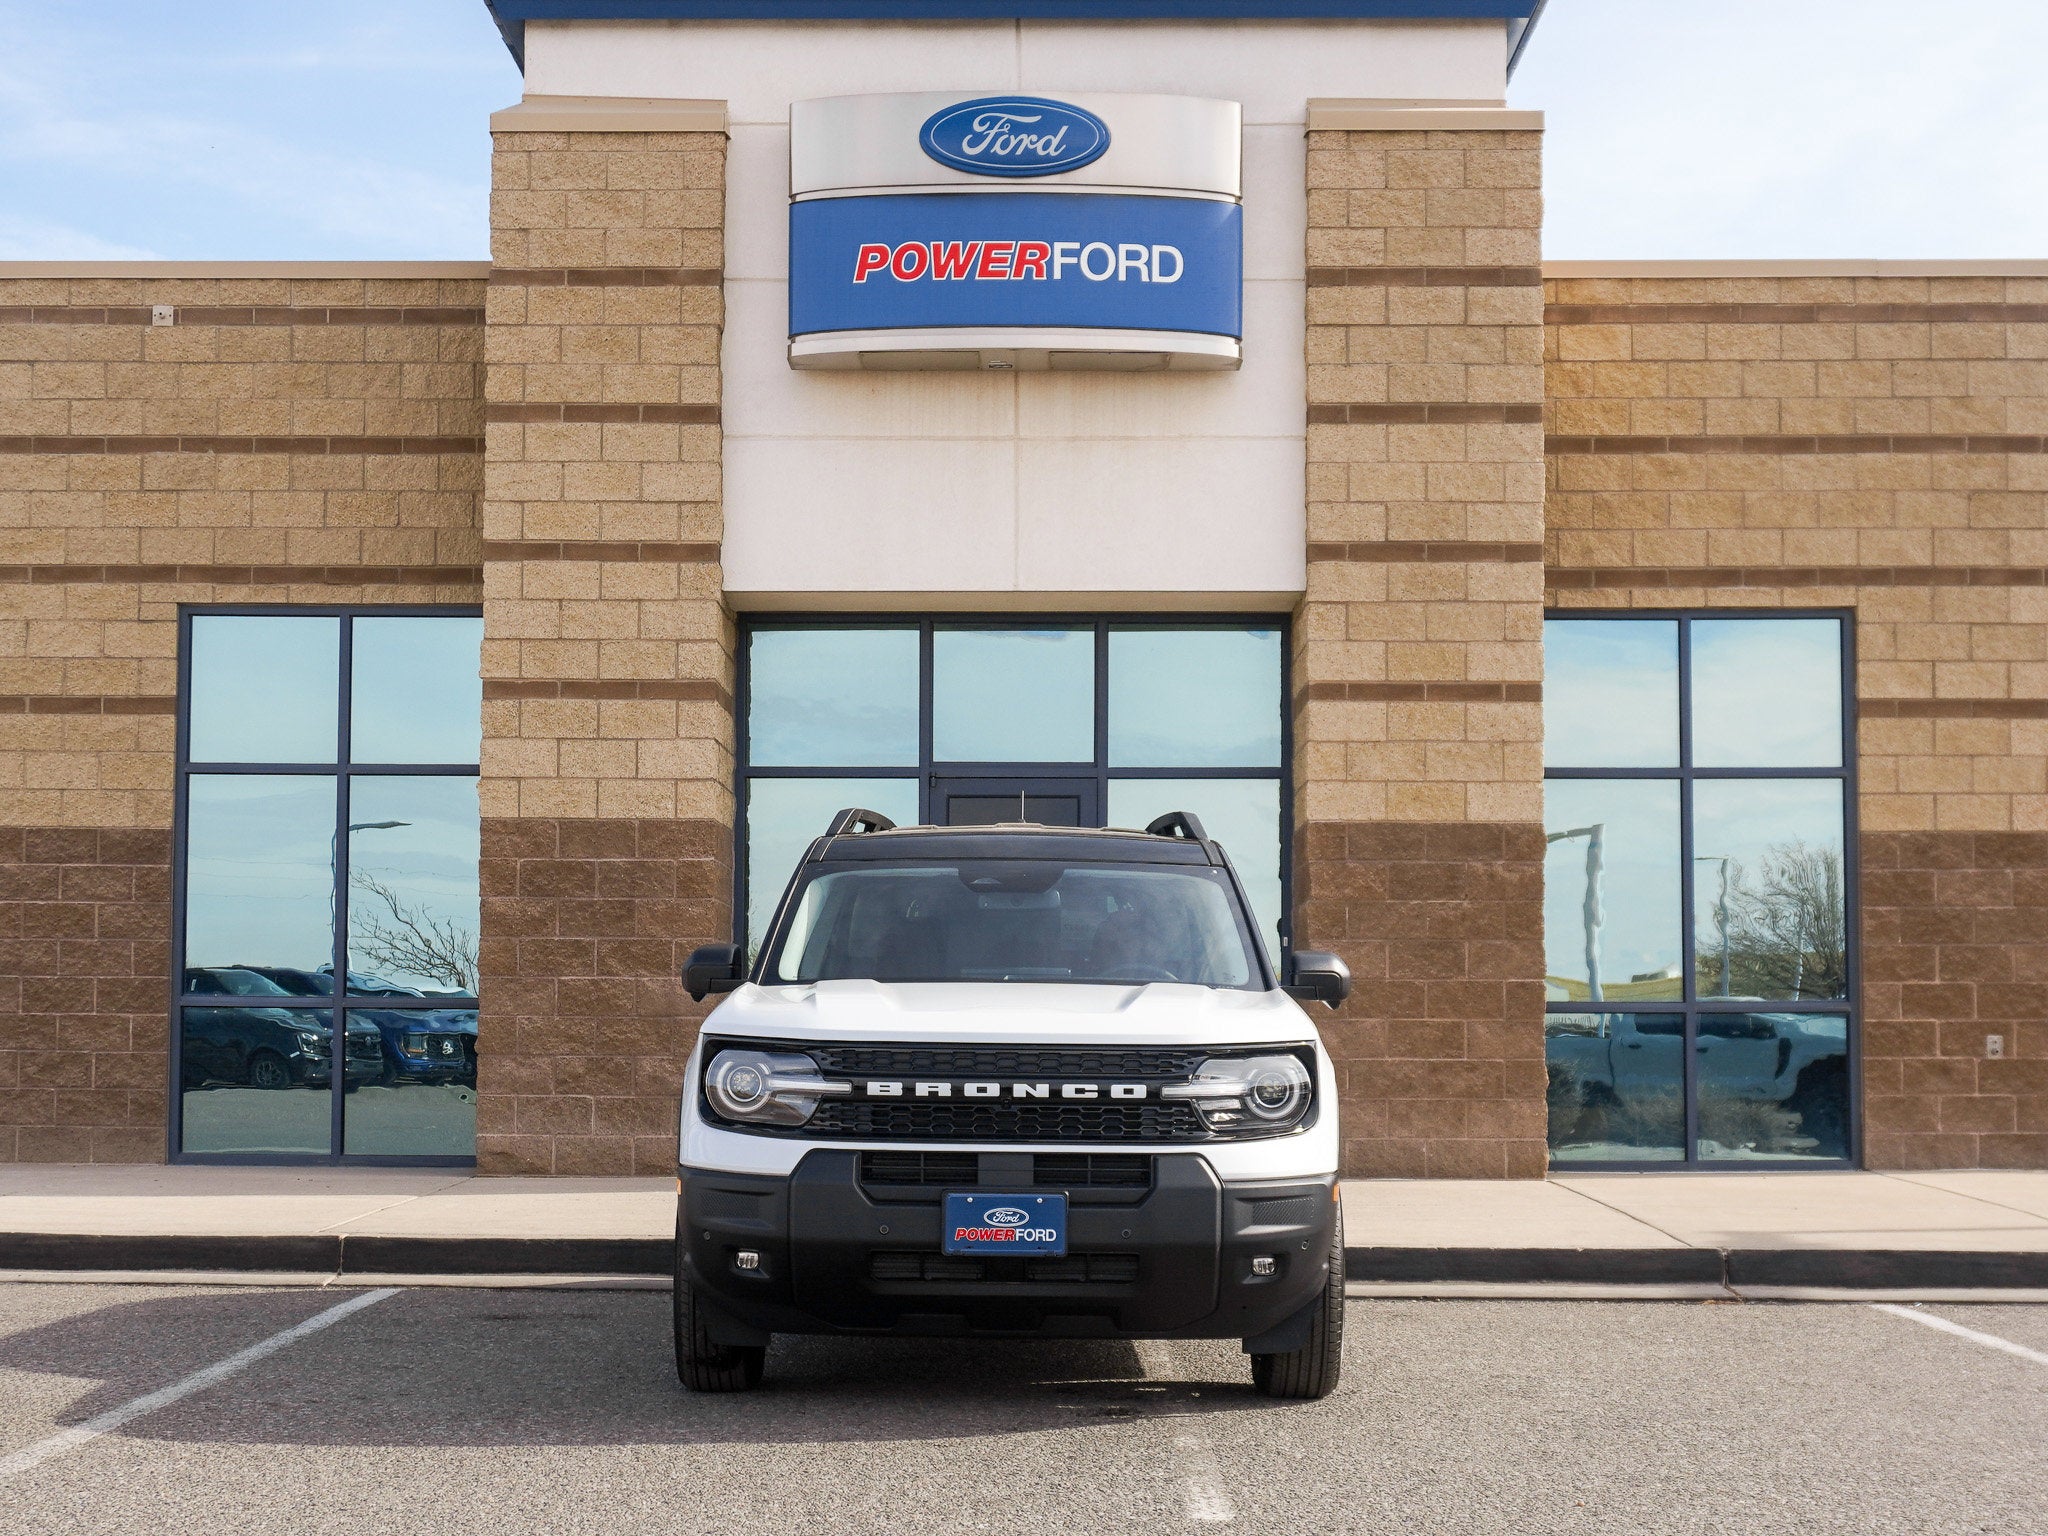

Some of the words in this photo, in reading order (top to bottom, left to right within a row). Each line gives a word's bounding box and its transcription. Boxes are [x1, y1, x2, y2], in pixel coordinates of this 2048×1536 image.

[961, 111, 1069, 157] Ford
[852, 240, 1184, 284] POWERFORD
[866, 1081, 1148, 1099] BRONCO
[992, 1210, 1020, 1224] Ford
[954, 1227, 1057, 1242] POWERFORD
